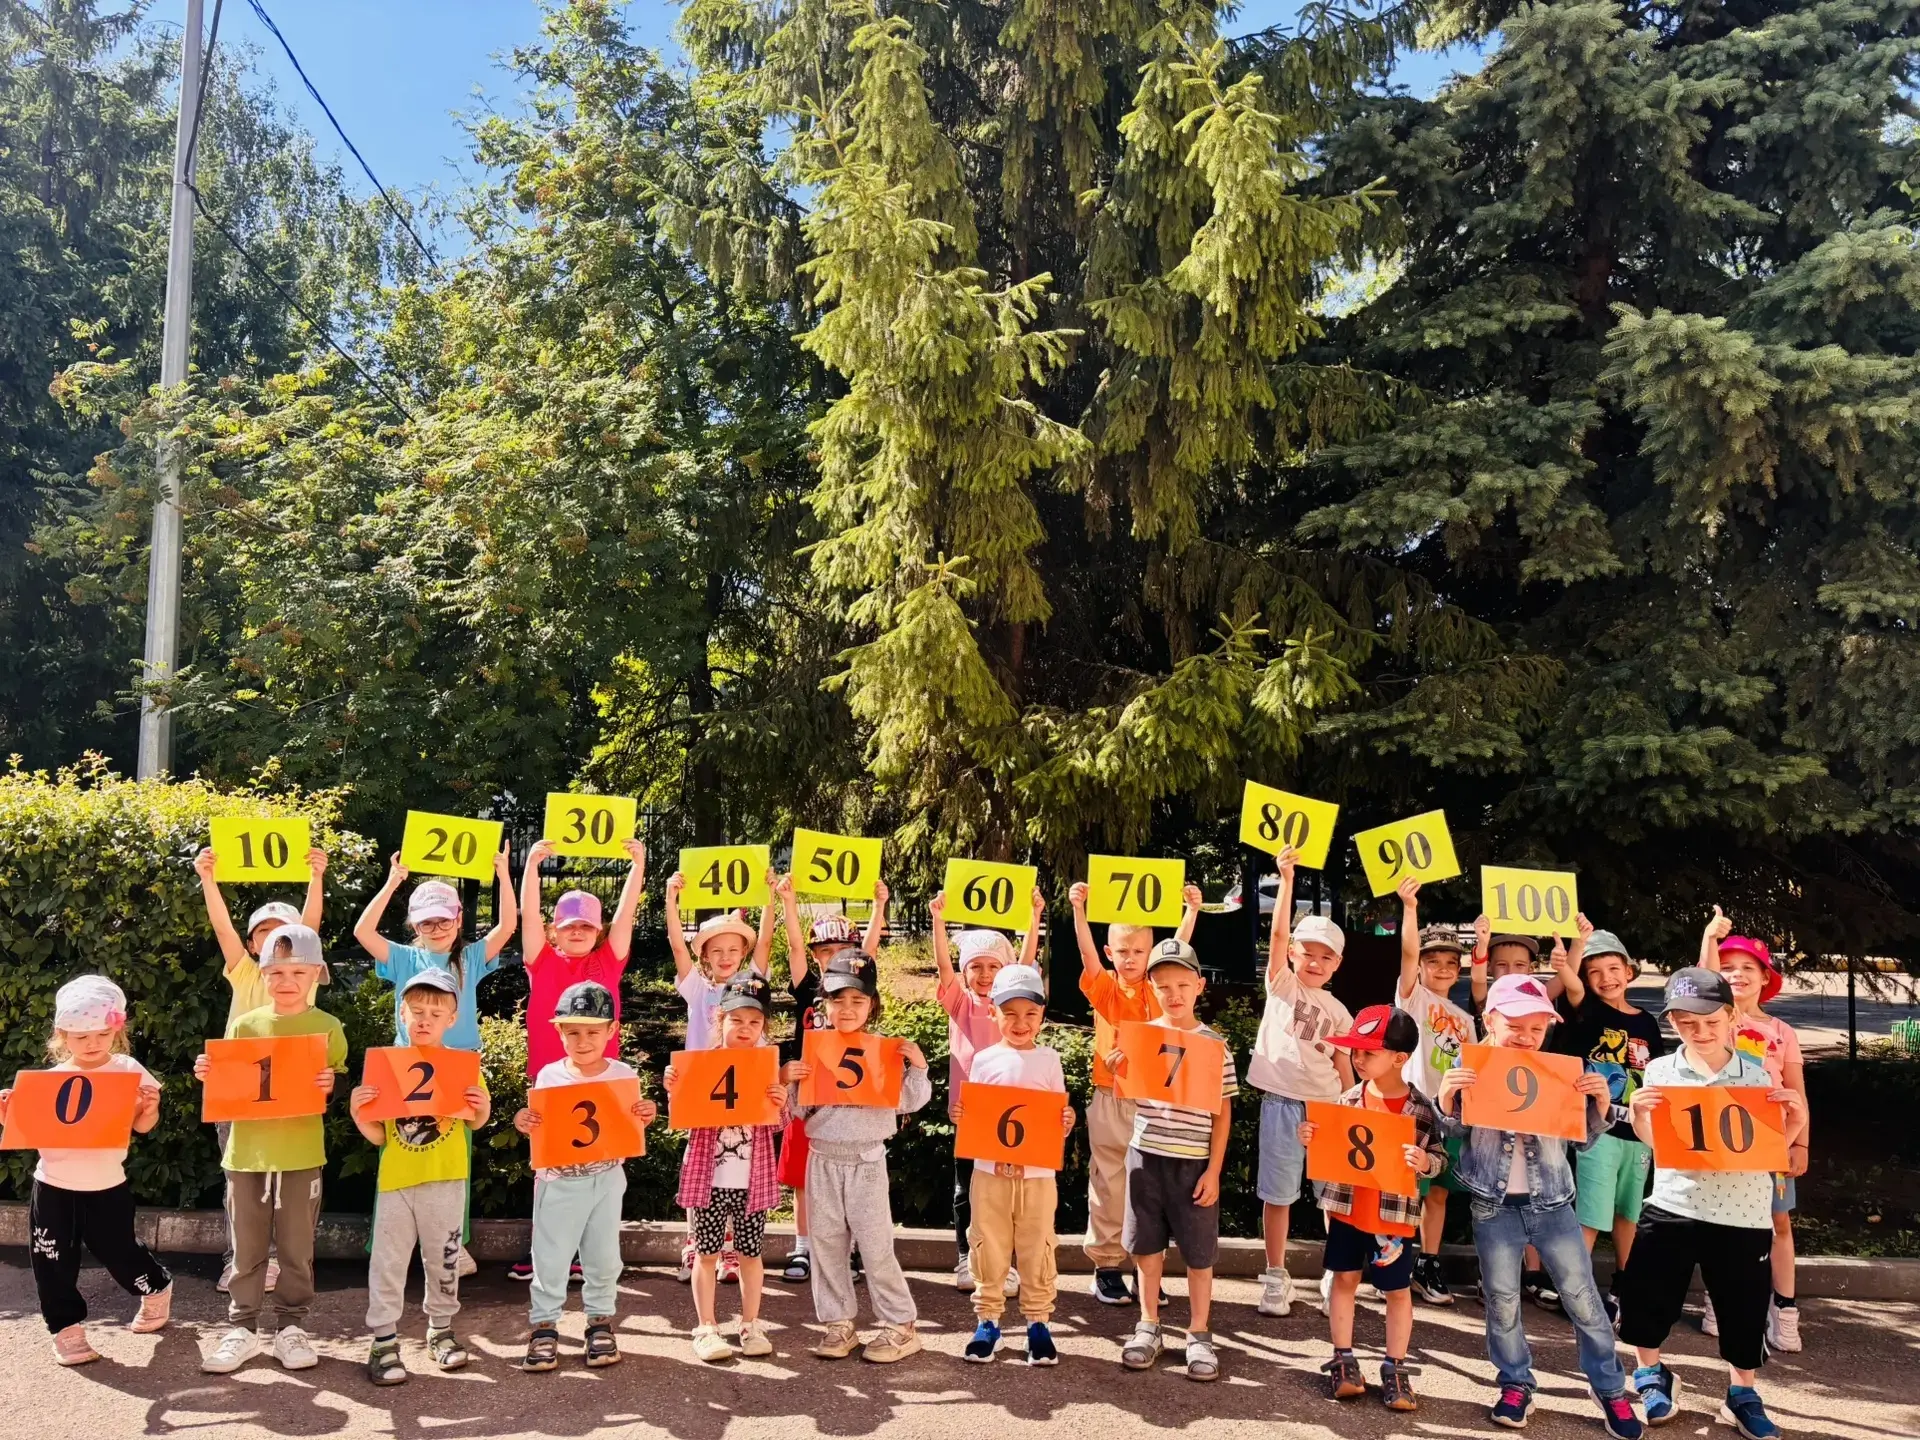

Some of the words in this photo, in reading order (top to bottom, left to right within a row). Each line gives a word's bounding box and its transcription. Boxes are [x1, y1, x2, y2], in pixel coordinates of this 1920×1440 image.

[422, 828, 476, 865] 20
[563, 808, 614, 844] 30
[1258, 803, 1309, 849] 80
[238, 832, 288, 868] 10
[809, 848, 859, 885] 50
[1378, 832, 1431, 879] 90
[699, 859, 749, 895] 40
[963, 876, 1013, 914] 60
[1109, 873, 1161, 912] 70
[1492, 883, 1571, 923] 100
[252, 1056, 277, 1102] 1
[404, 1062, 434, 1101] 2
[836, 1047, 865, 1089] 5
[1158, 1044, 1186, 1087] 7
[54, 1075, 93, 1125] 0
[710, 1065, 738, 1109] 4
[1507, 1067, 1538, 1111] 9
[572, 1101, 599, 1148] 3
[997, 1105, 1024, 1147] 6
[1681, 1103, 1754, 1154] 10
[1348, 1125, 1375, 1171] 8
